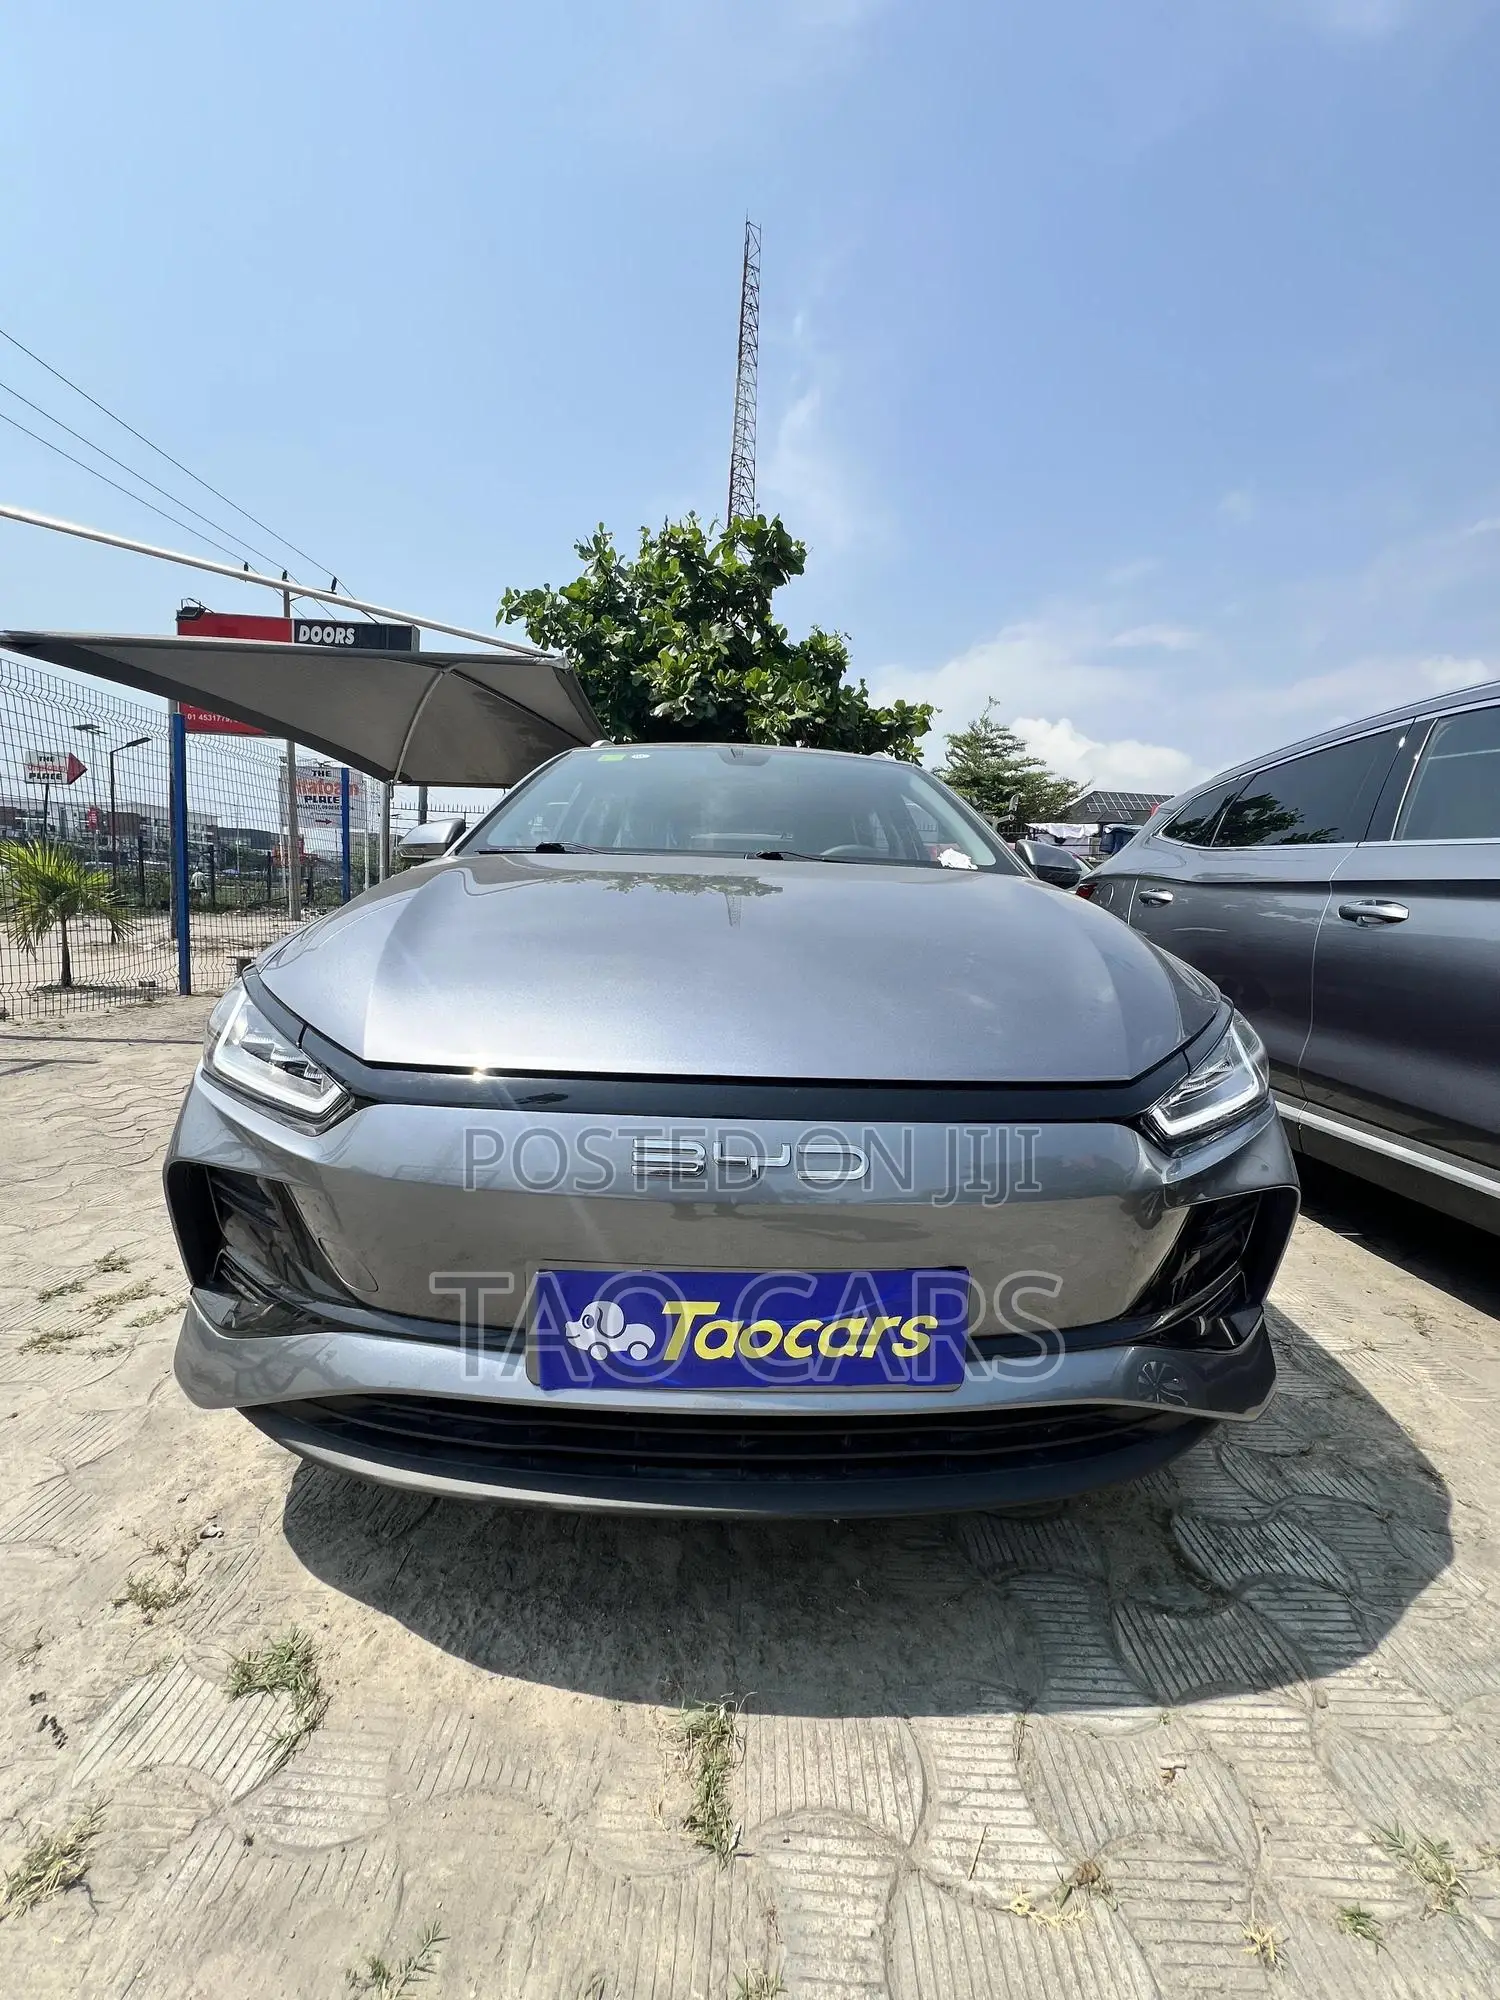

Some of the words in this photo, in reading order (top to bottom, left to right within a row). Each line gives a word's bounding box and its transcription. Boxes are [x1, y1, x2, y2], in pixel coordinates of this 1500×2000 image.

[299, 624, 355, 645] DOORS
[187, 713, 196, 721] 01
[311, 769, 332, 777] THE
[304, 795, 341, 804] PLACE
[631, 1137, 870, 1181] BYD
[661, 1301, 938, 1361] Taocars
